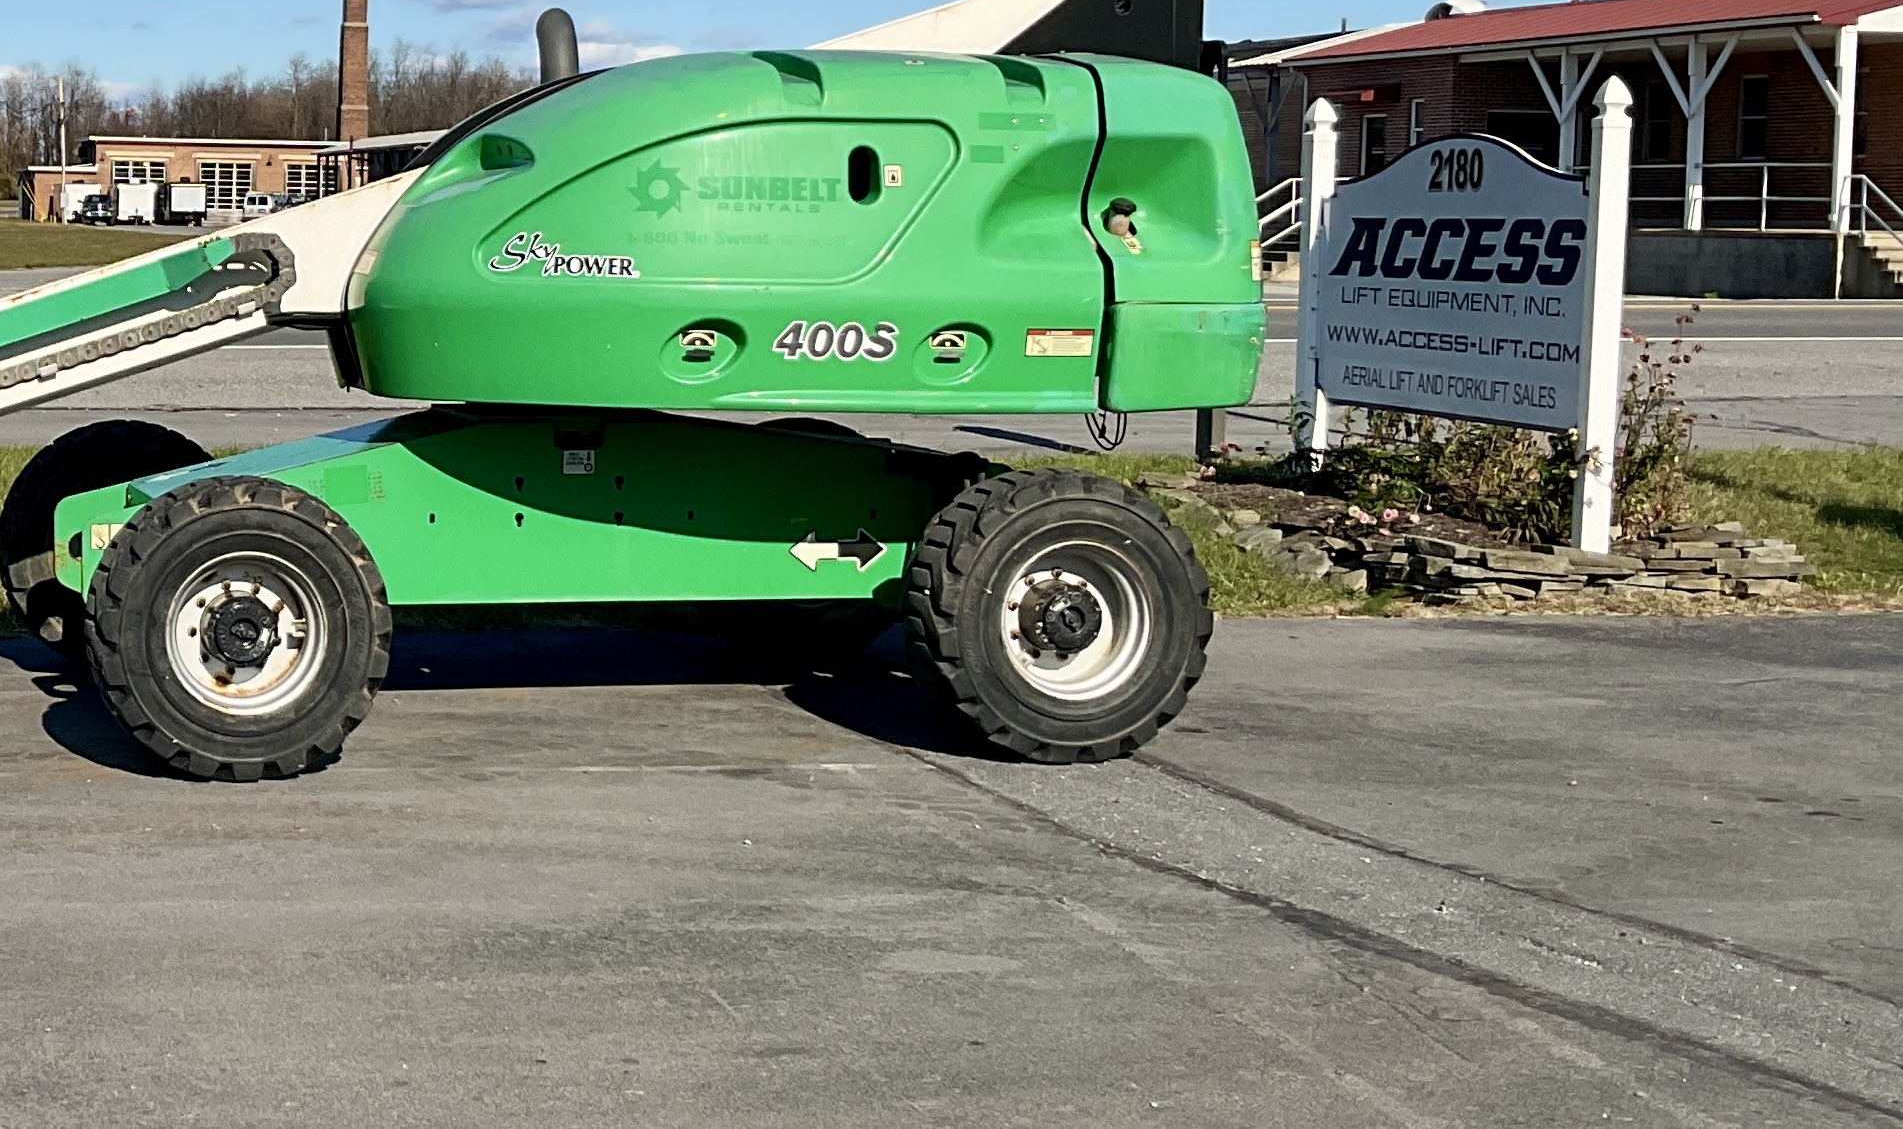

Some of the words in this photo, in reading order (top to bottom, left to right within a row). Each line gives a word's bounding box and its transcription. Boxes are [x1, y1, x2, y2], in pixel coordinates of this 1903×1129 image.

[697, 175, 842, 202] SUNBELT
[1428, 148, 1484, 191] 2180
[718, 203, 821, 213] RENTALS
[490, 233, 559, 275] Sky
[553, 255, 633, 277] POWER
[1328, 217, 1588, 286] ACCESS
[1341, 286, 1382, 306] LIFT
[1388, 288, 1517, 318] EQUIPMENT,
[1524, 295, 1566, 318] INC.
[773, 320, 899, 360] 400S
[1327, 324, 1580, 365] WWW.ACCESS-LIFT.COM
[1342, 365, 1386, 390] AERIAL
[1389, 368, 1414, 392] LIFT
[1416, 372, 1443, 396] AND
[1447, 375, 1509, 405] FORKLIFT
[1512, 382, 1556, 410] SALES
